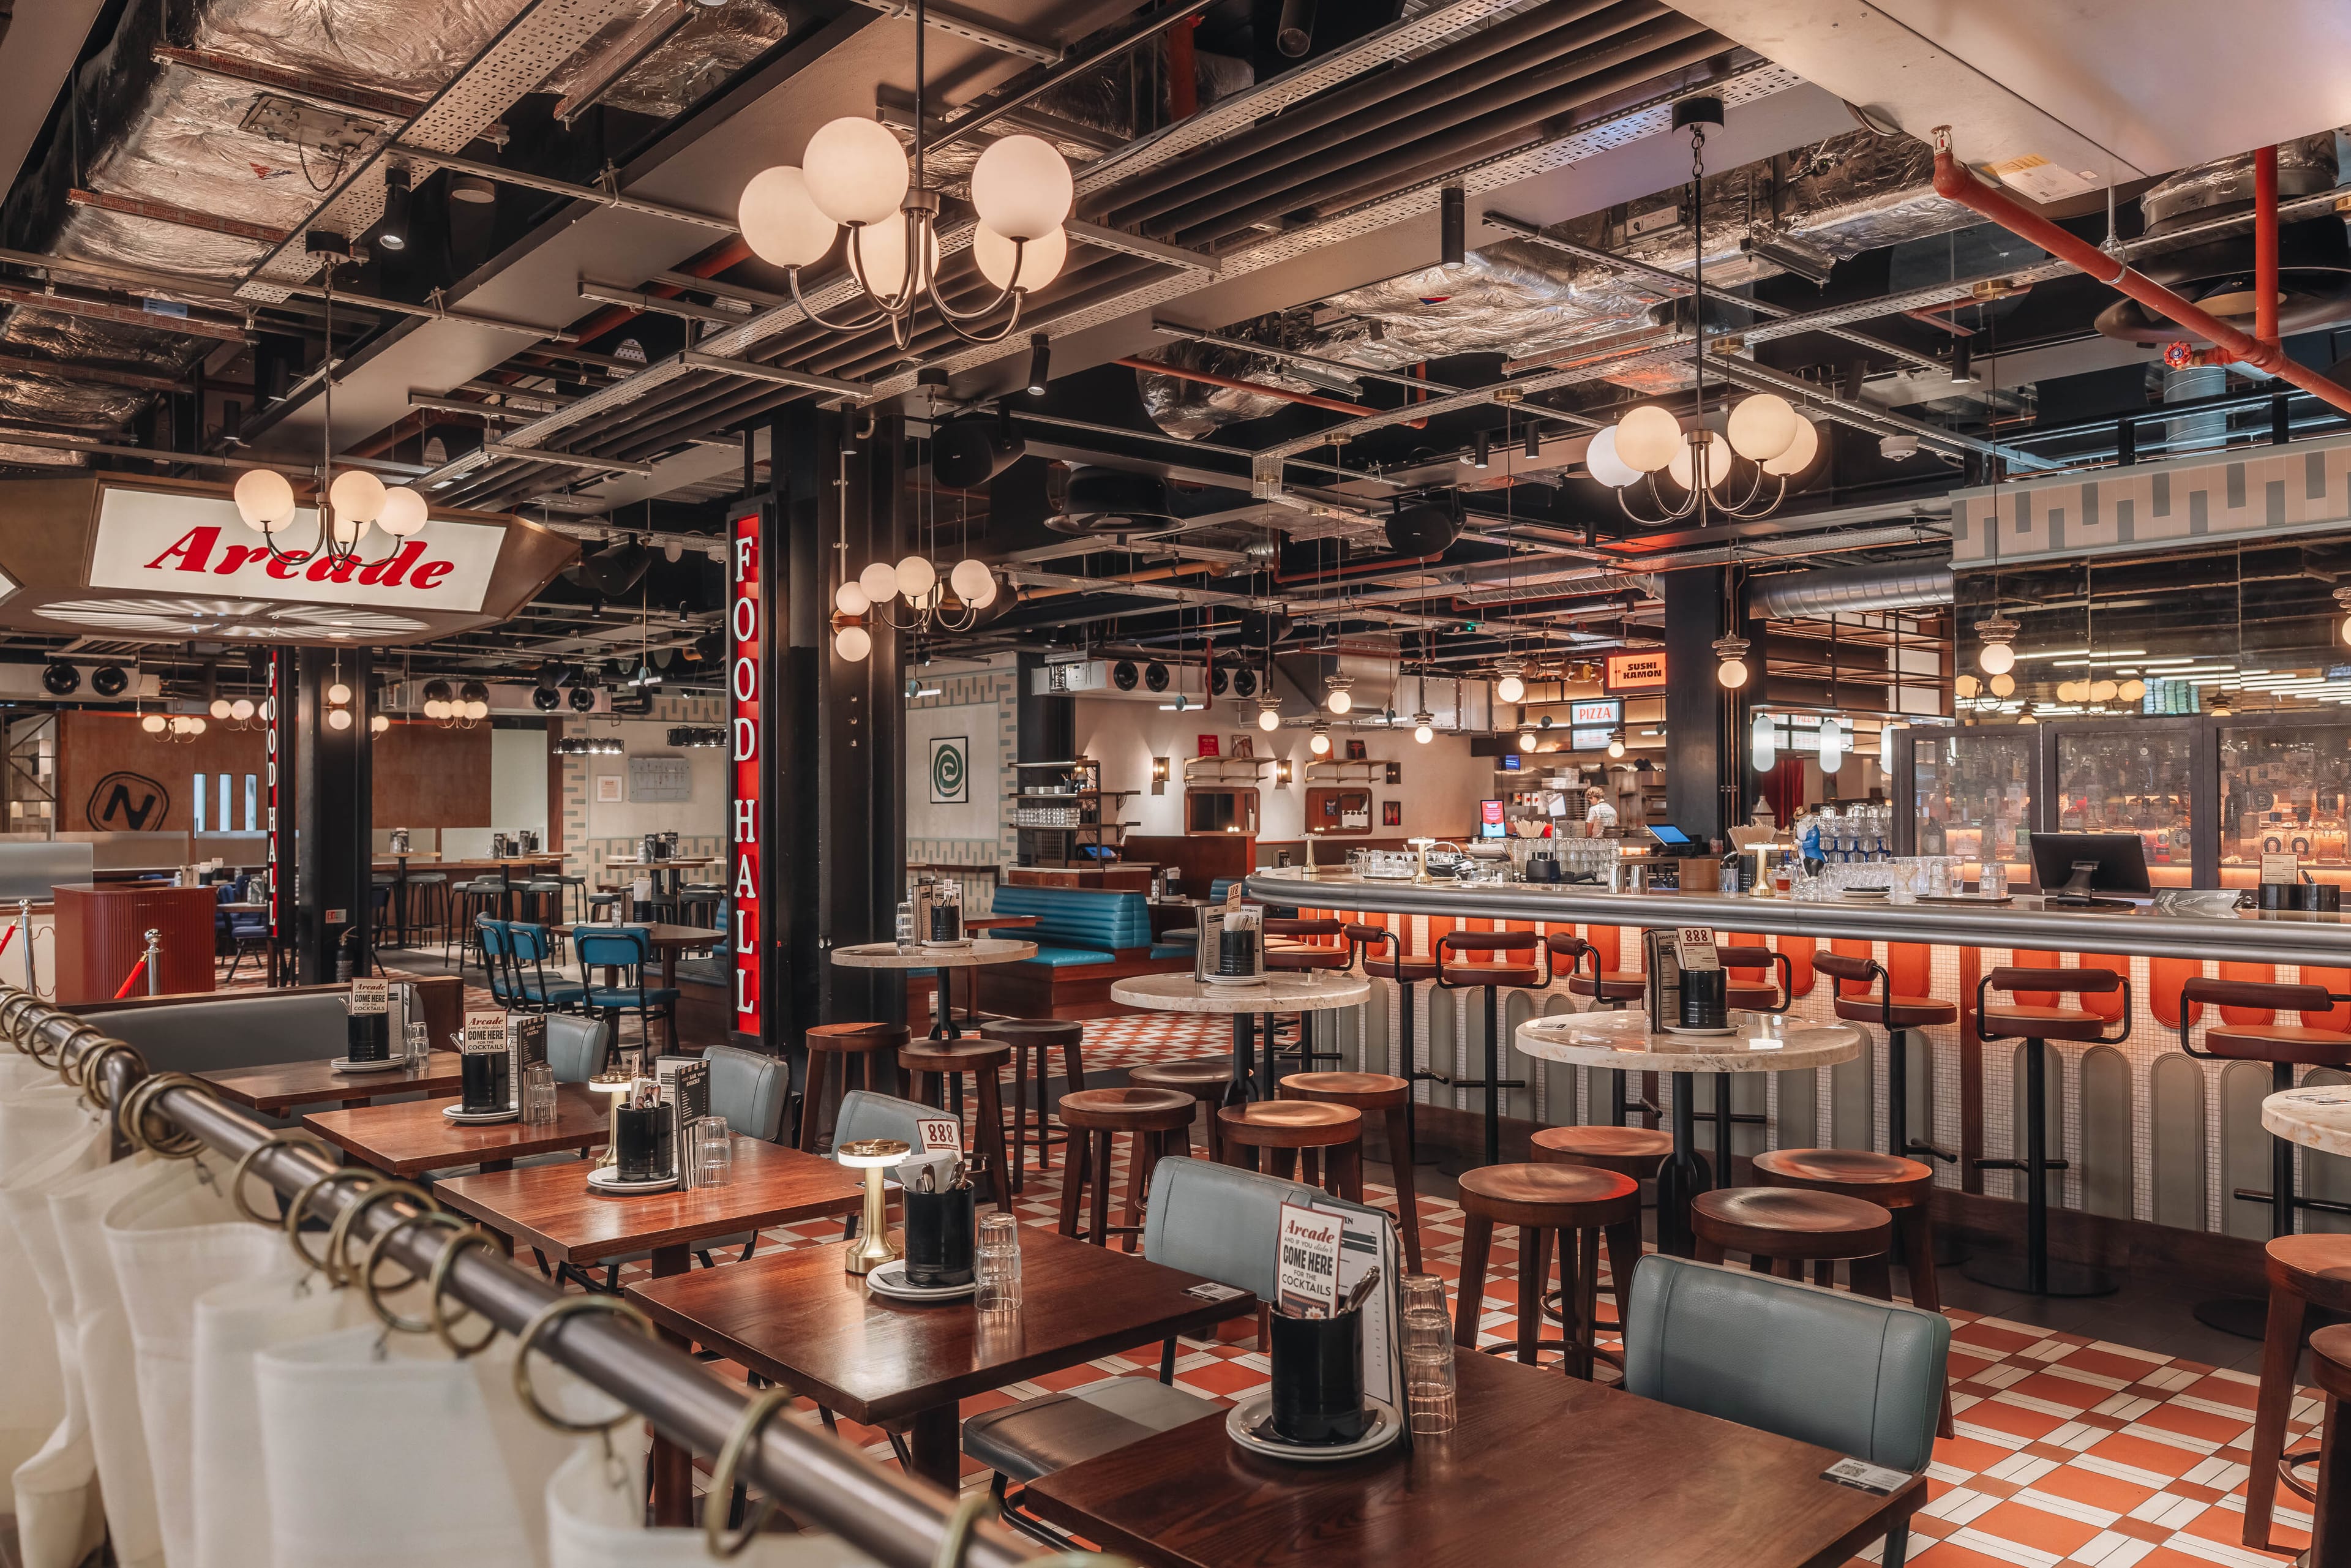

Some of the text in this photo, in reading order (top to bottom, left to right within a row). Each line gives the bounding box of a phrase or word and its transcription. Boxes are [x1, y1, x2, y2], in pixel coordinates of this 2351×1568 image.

[209, 56, 252, 71] FIREDUCT
[258, 68, 301, 83] FIREDUCT
[101, 197, 138, 208] FIREDUCT
[143, 204, 179, 216] FIREDUCT
[185, 214, 219, 225] FIREDUCT
[225, 222, 258, 233] FIREDUCT
[84, 304, 114, 313] FIREDUCT
[119, 310, 149, 320] FIREDUCT
[153, 317, 182, 326] FIREDUCT
[144, 526, 454, 589] Arcade
[1627, 662, 1657, 671] SUSHI
[1623, 670, 1662, 679] KAMON
[1579, 707, 1611, 720] PIZZA
[734, 536, 756, 1013] FOOD HALL
[103, 784, 156, 831] N
[1685, 929, 1708, 942] 888
[468, 1017, 503, 1026] Arcade
[468, 1030, 503, 1040] COME HERE
[686, 1078, 700, 1087] SNACKS
[928, 1124, 953, 1143] 888
[1285, 1220, 1335, 1244] Arcade
[1283, 1244, 1333, 1277] COME HERE
[1282, 1274, 1331, 1297] COCKTAILS
